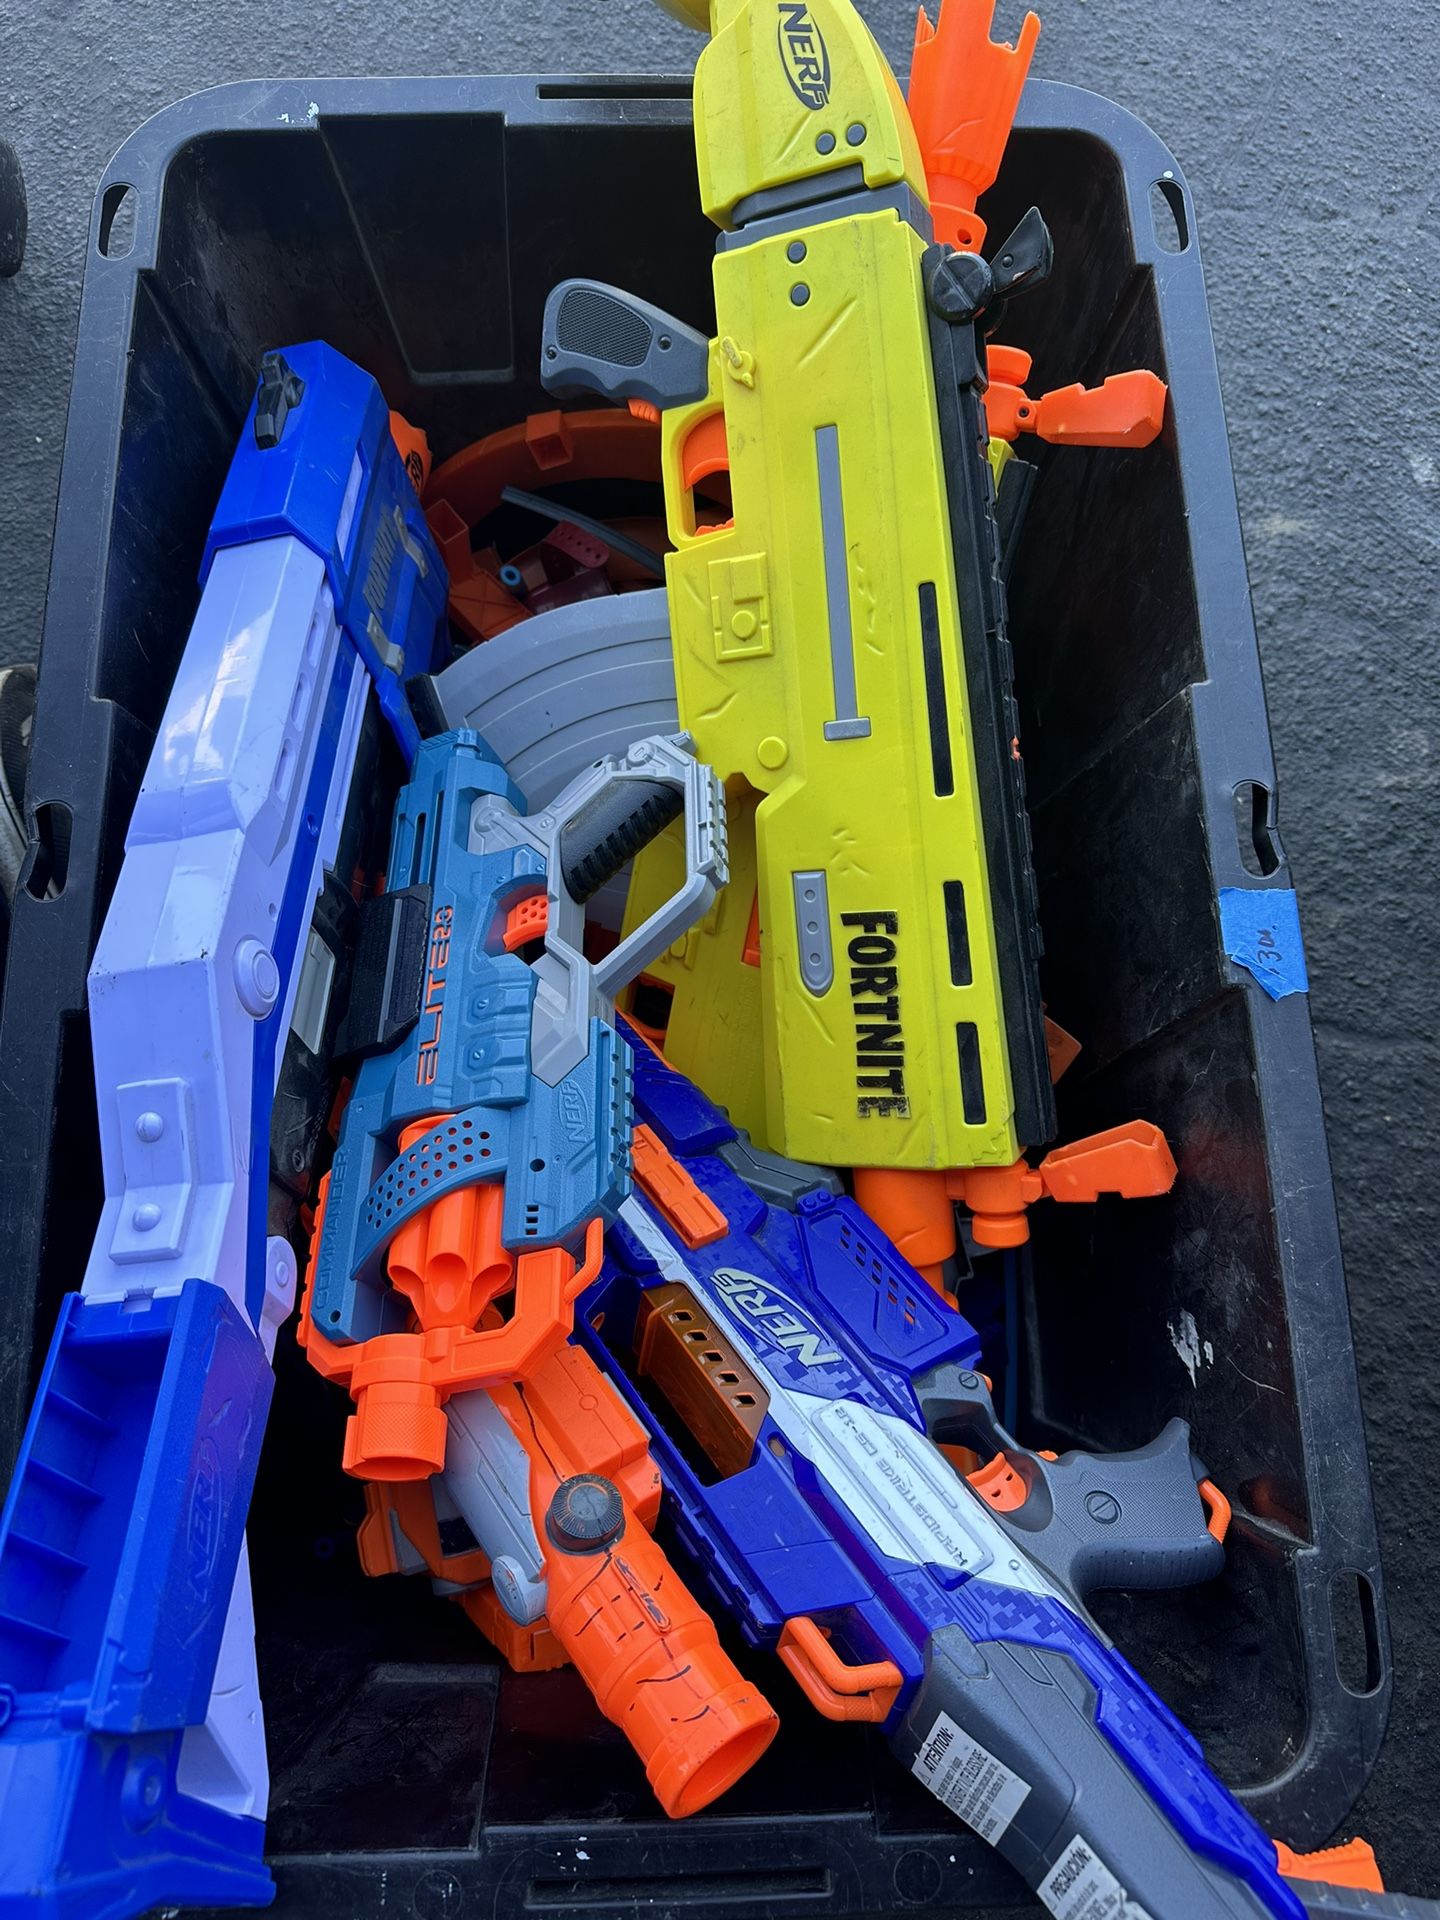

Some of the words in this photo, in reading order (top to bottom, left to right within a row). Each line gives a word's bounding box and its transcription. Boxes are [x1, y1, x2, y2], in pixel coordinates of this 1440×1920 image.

[778, 3, 830, 110] NERF
[416, 940, 450, 1086] ELITE
[840, 911, 911, 1119] FORTNITE
[558, 1079, 588, 1143] NERF
[315, 1150, 349, 1309] COMMANDER
[709, 1267, 844, 1368] NERF
[186, 1437, 222, 1603] NERF
[875, 1457, 968, 1567] RAPIDSTRIKE
[923, 1727, 954, 1774] ATTENTION:
